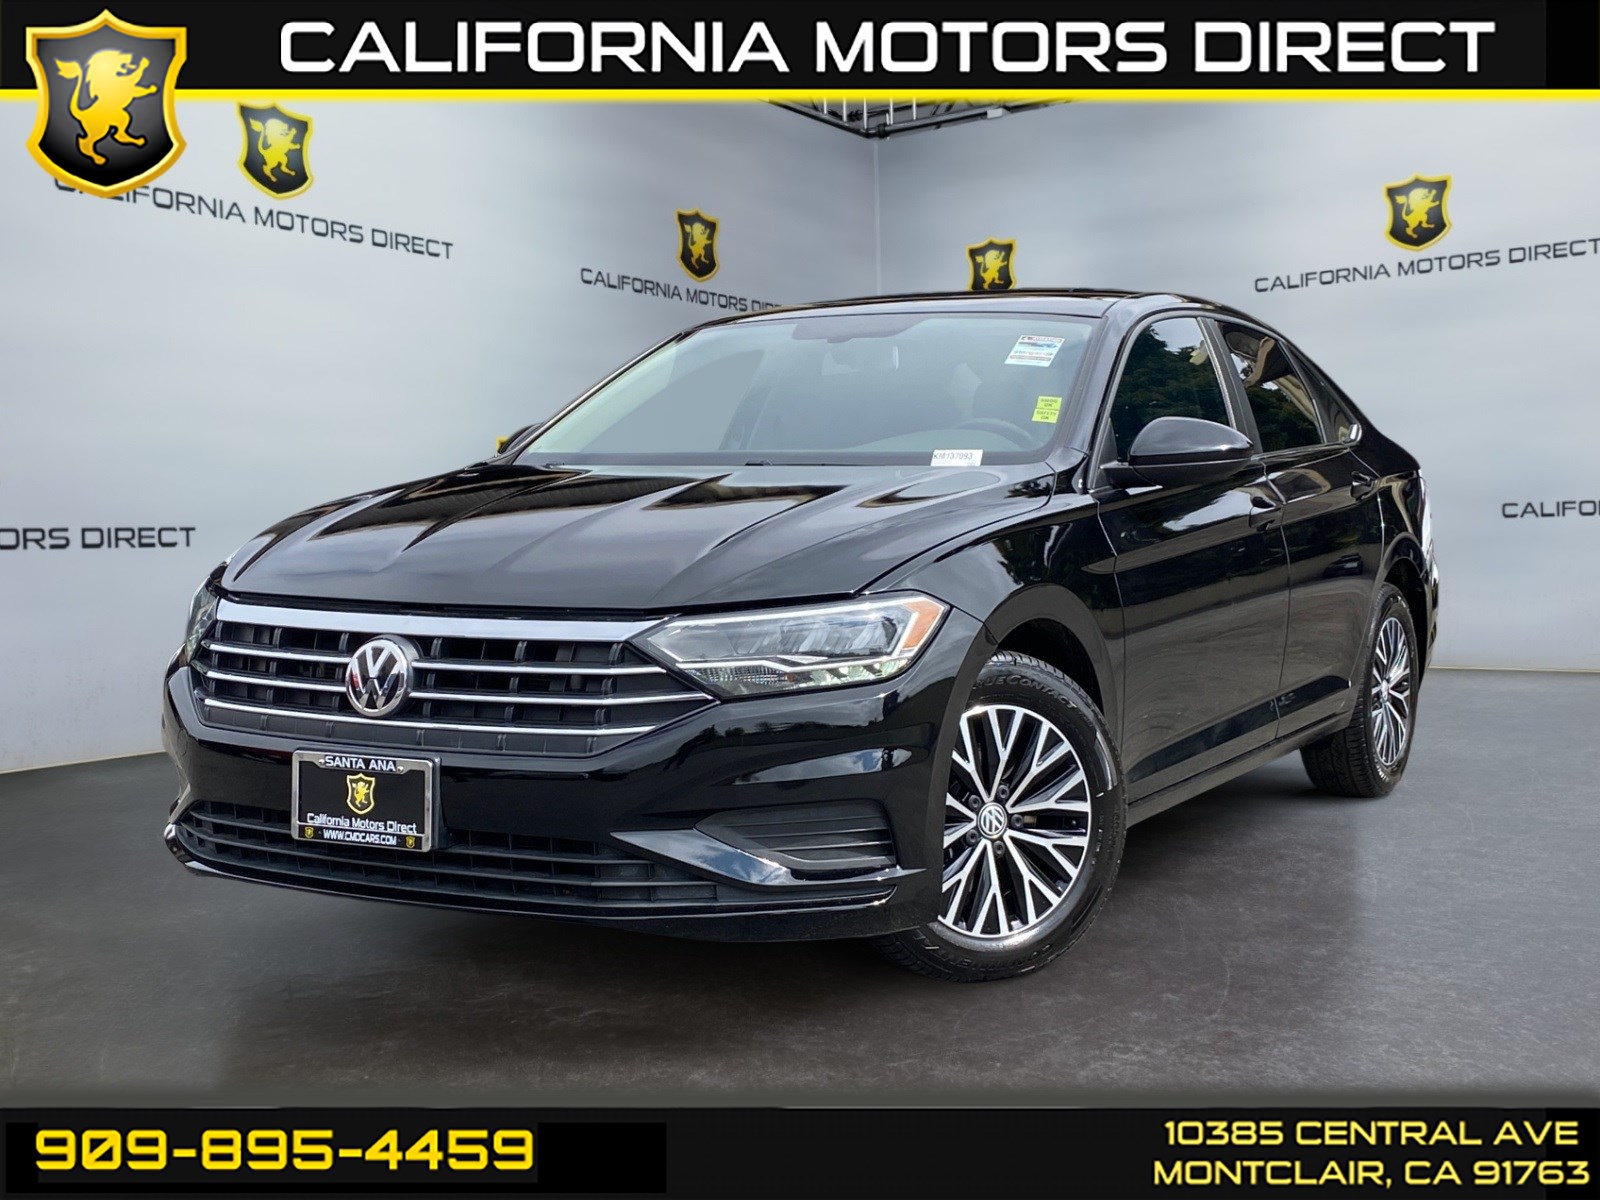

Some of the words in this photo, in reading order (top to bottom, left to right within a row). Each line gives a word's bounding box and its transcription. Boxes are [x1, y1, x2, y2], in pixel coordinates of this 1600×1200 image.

[254, 206, 364, 243] MOTORS
[371, 228, 454, 259] DIRECT
[1254, 263, 1391, 293] CALIFORNIA
[1398, 250, 1501, 276] MOTORS
[1508, 237, 1600, 264] DIRECT
[580, 267, 682, 300] CALIFORNIA
[686, 287, 748, 312] MOTORS
[1502, 500, 1600, 519] CALIFO
[81, 526, 196, 549] DIRECT
[325, 755, 366, 770] SANTA
[368, 758, 396, 772] ANA
[306, 812, 350, 827] California
[351, 816, 385, 831] Motors
[386, 820, 418, 834] Direct
[322, 828, 398, 846] WWW.CMDCARS.COM
